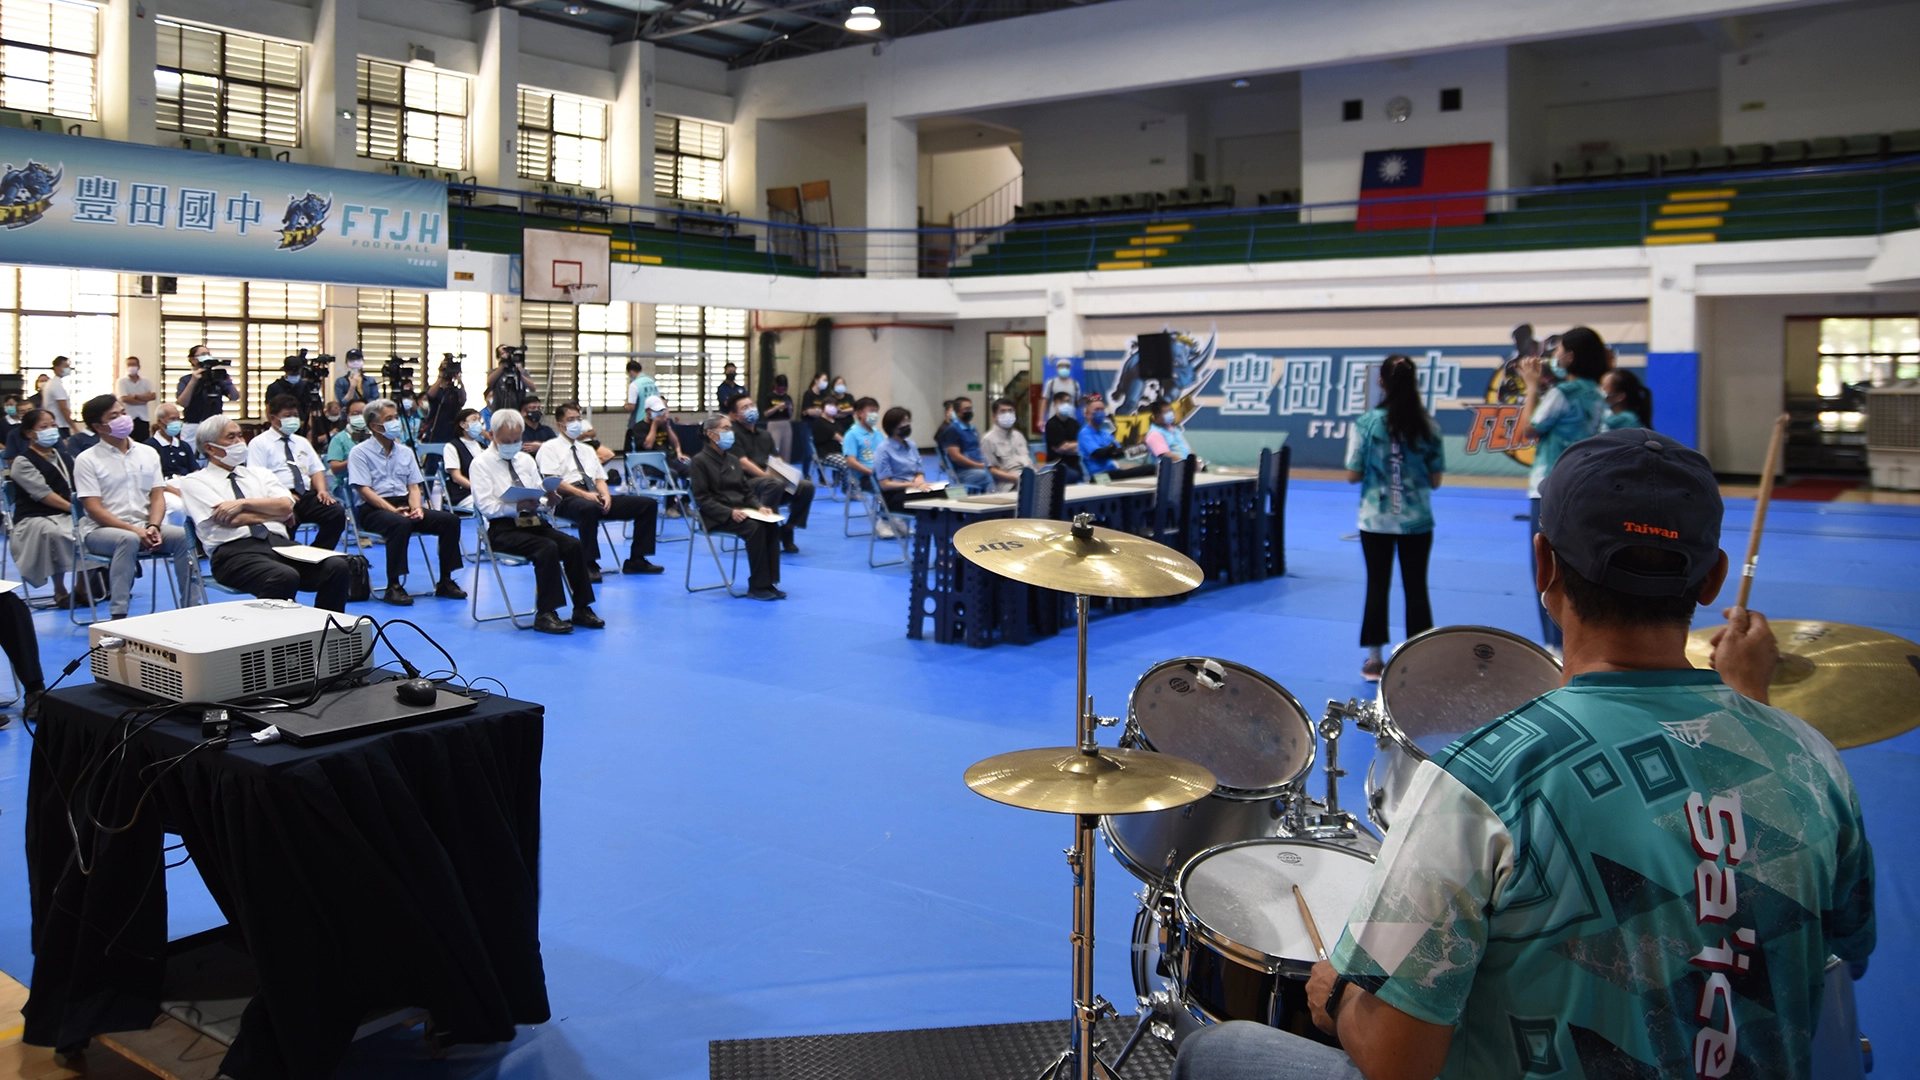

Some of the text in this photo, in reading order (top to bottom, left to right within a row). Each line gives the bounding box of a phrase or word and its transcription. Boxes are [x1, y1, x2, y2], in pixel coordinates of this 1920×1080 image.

[72, 176, 263, 236] 豐田國中
[340, 204, 441, 245] FTJH
[352, 240, 430, 253] FOOTBALL
[1623, 521, 1679, 539] Taiwan
[975, 540, 1024, 553] sbr
